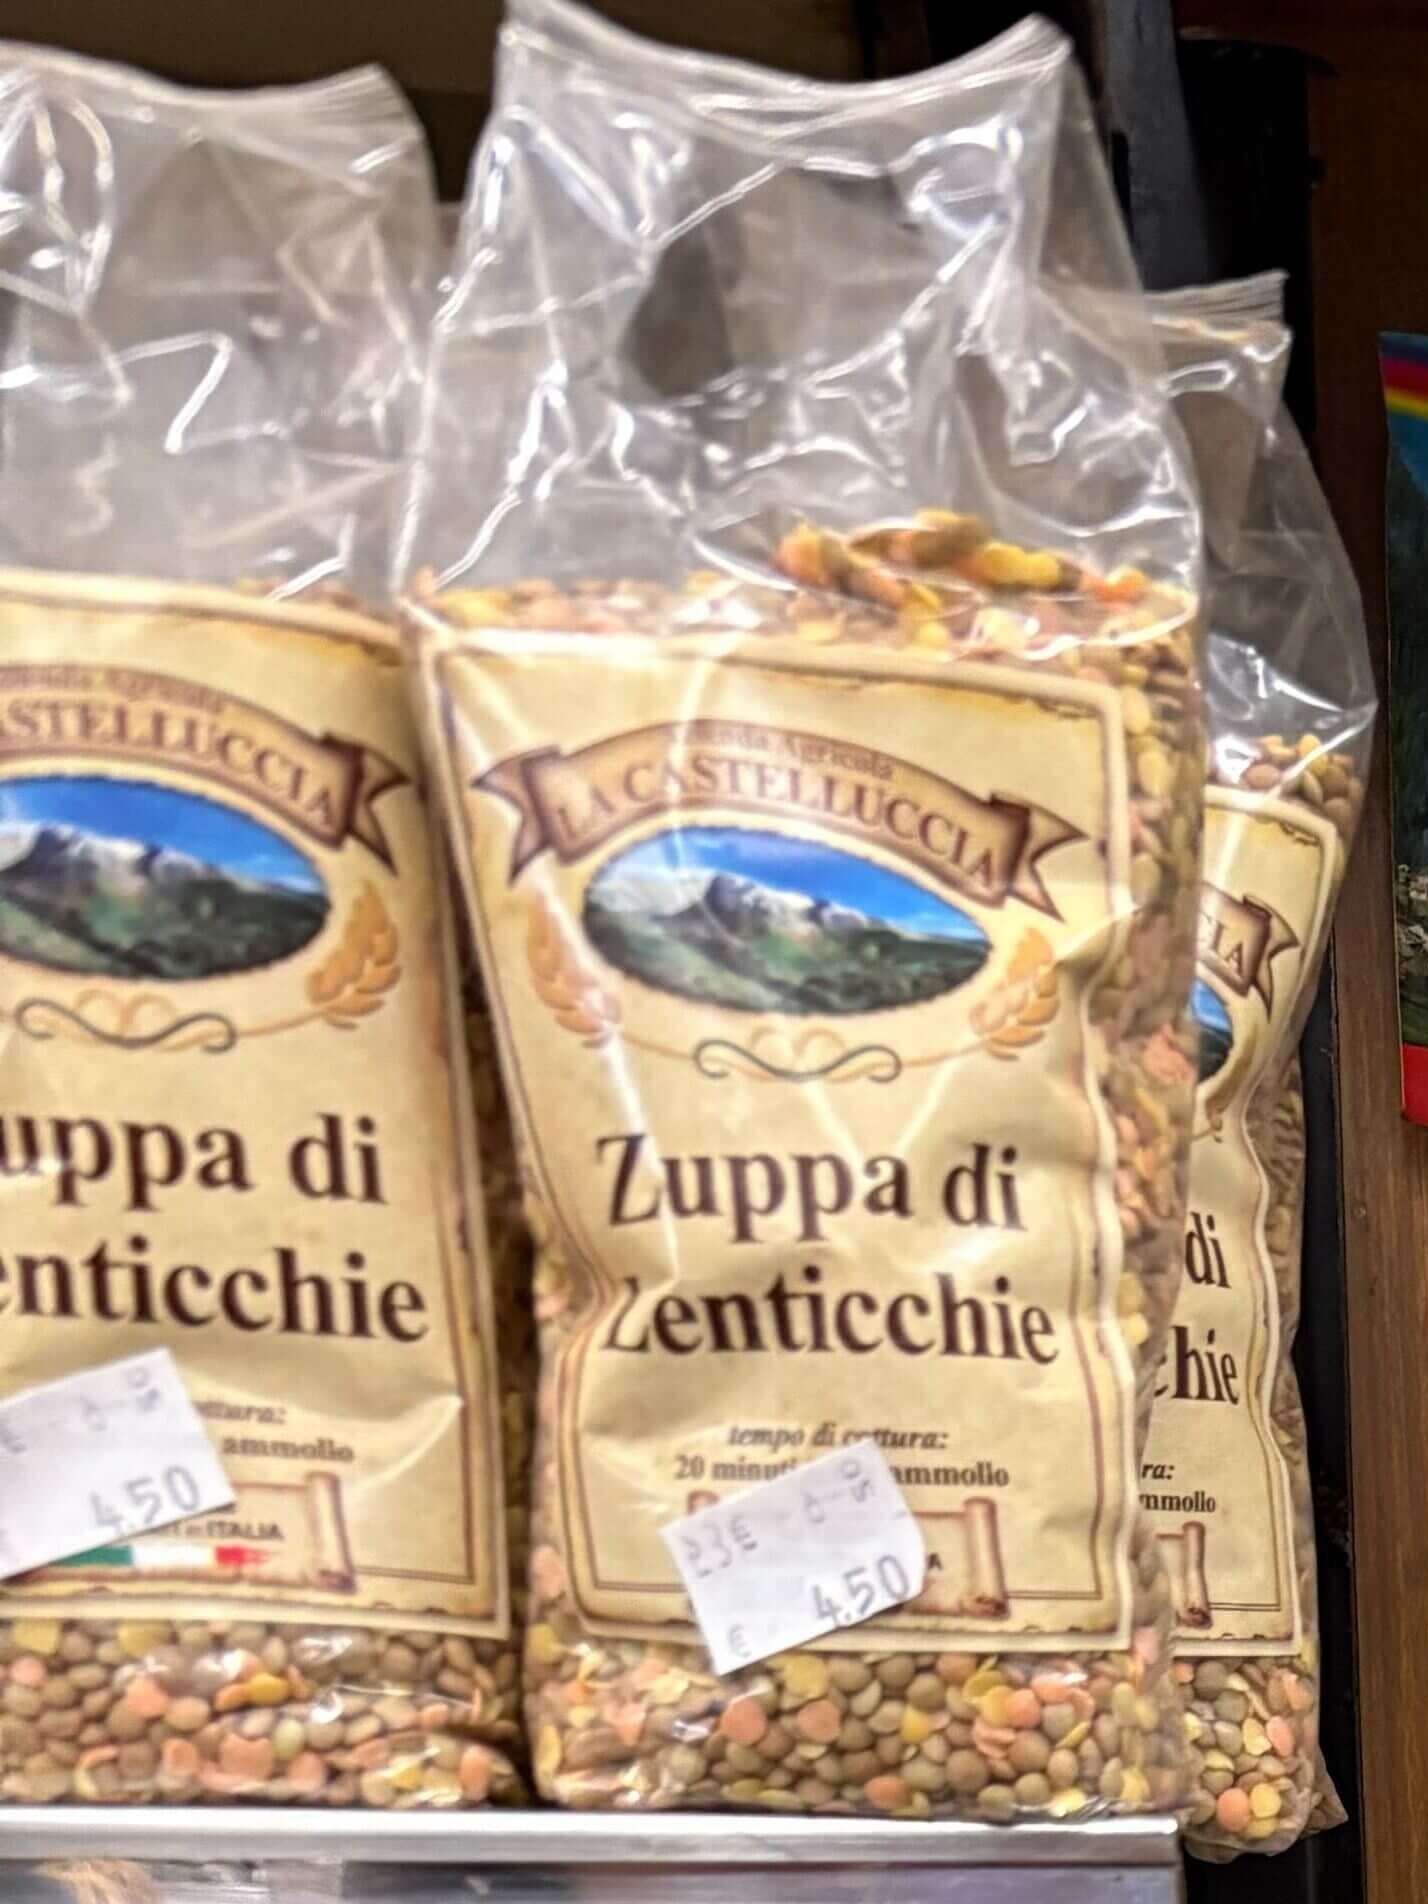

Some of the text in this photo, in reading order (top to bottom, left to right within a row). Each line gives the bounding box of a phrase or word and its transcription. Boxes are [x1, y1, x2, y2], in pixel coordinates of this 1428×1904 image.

[0, 1113, 388, 1212] uppa di
[596, 1133, 1026, 1243] Zuppa di
[0, 1235, 429, 1342] nticchie
[603, 1264, 1059, 1364] Lenticchie
[221, 1436, 355, 1463] ammollo
[675, 1457, 706, 1477] 20
[729, 1425, 804, 1451] tempo
[810, 1422, 836, 1446] di
